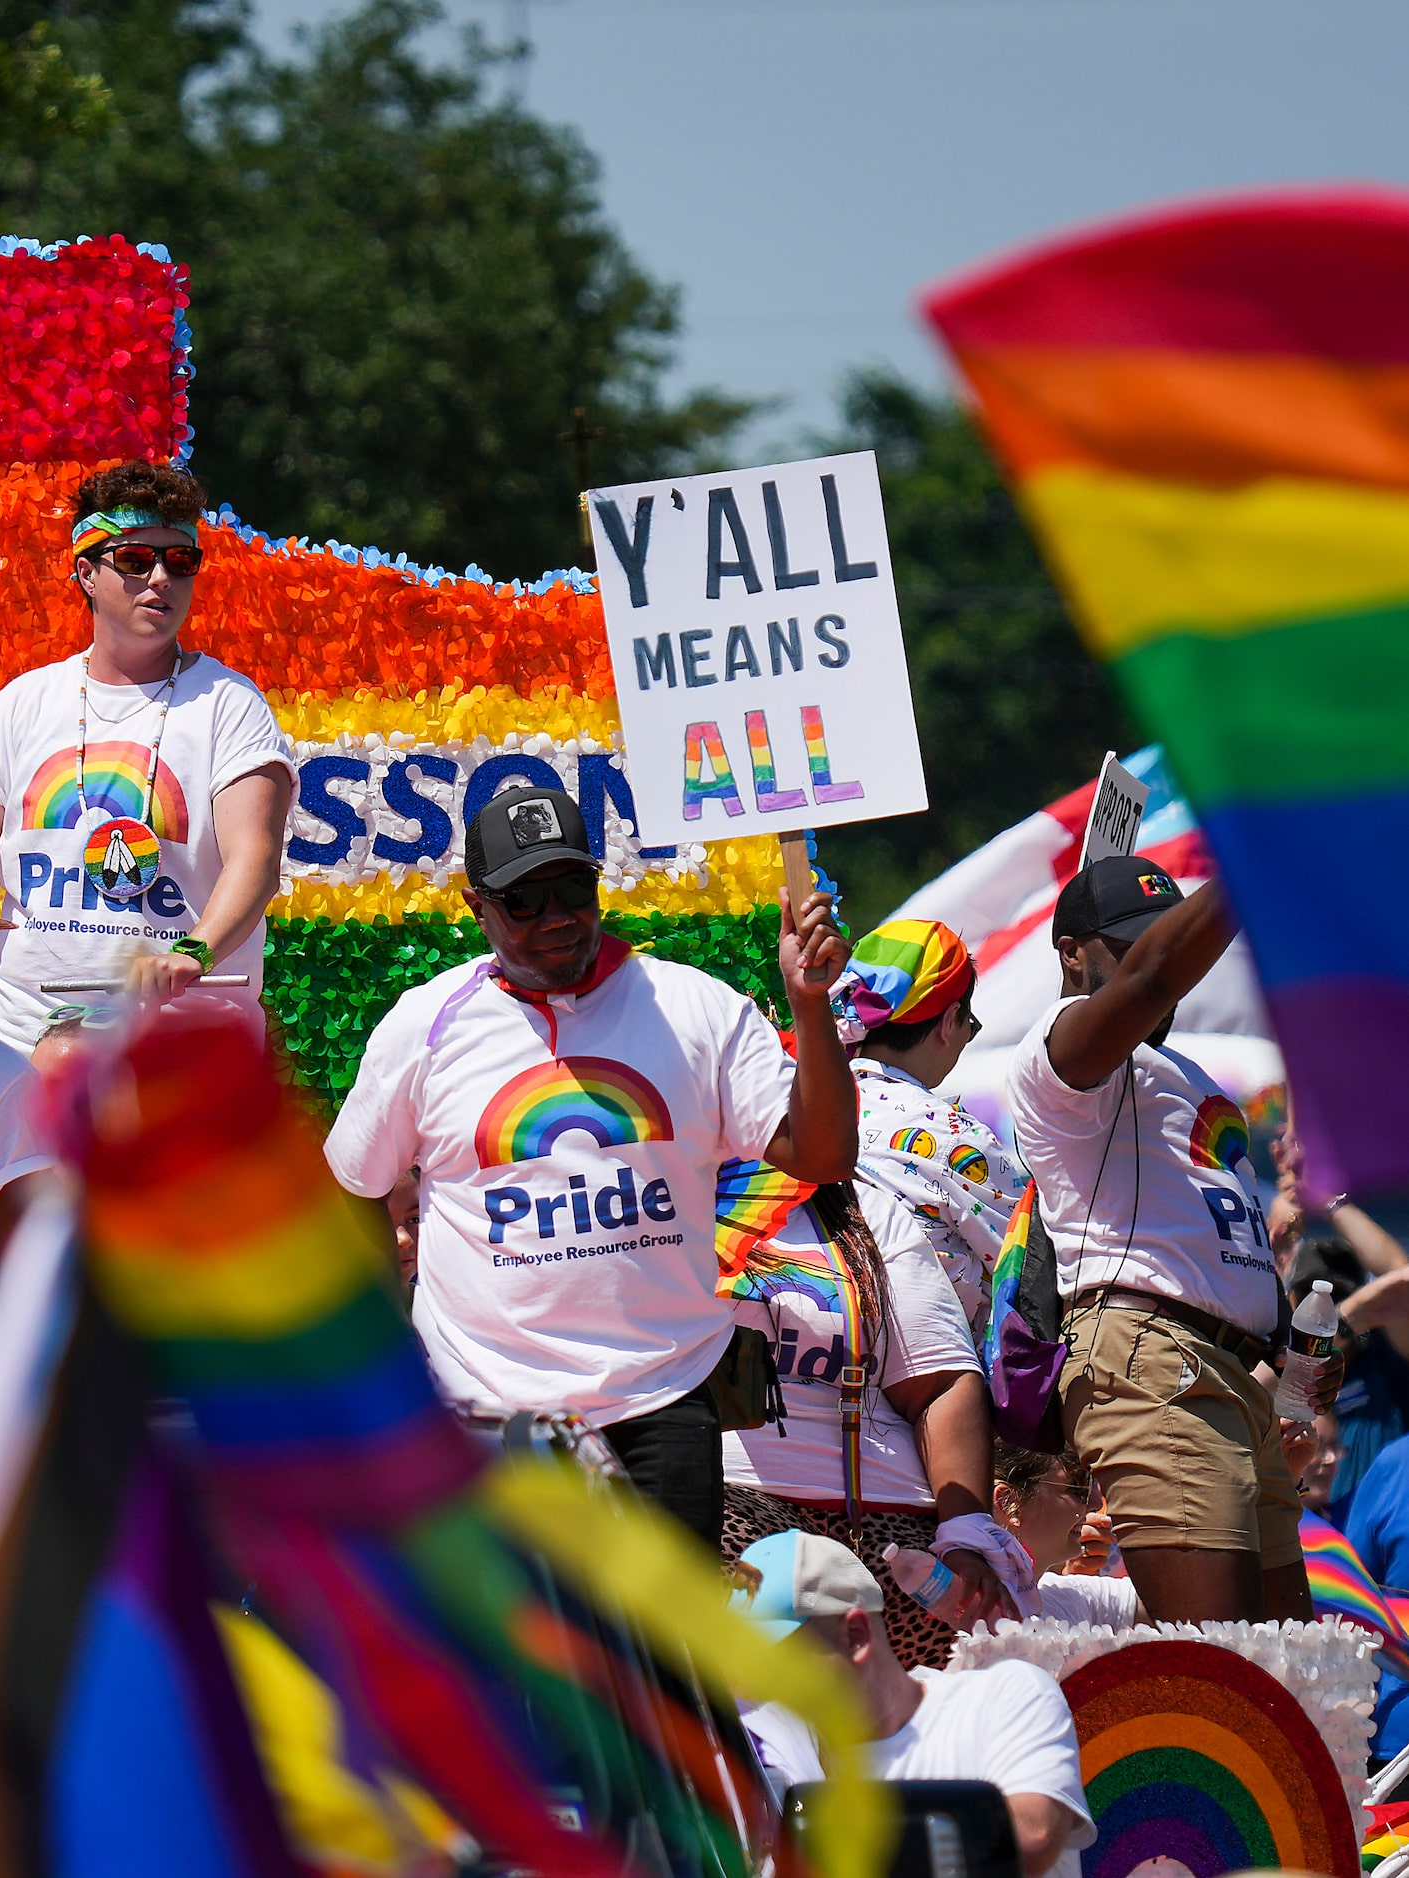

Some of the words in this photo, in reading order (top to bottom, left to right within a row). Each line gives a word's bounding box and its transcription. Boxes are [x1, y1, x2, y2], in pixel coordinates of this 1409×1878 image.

[594, 473, 878, 608] Y'ALL
[633, 614, 851, 690] MEANS
[683, 705, 865, 822] ALL
[68, 919, 140, 936] Resource
[484, 1166, 676, 1244] Pride
[492, 1247, 563, 1267] Employee
[566, 1239, 638, 1260] Resource
[639, 1232, 684, 1248] Group
